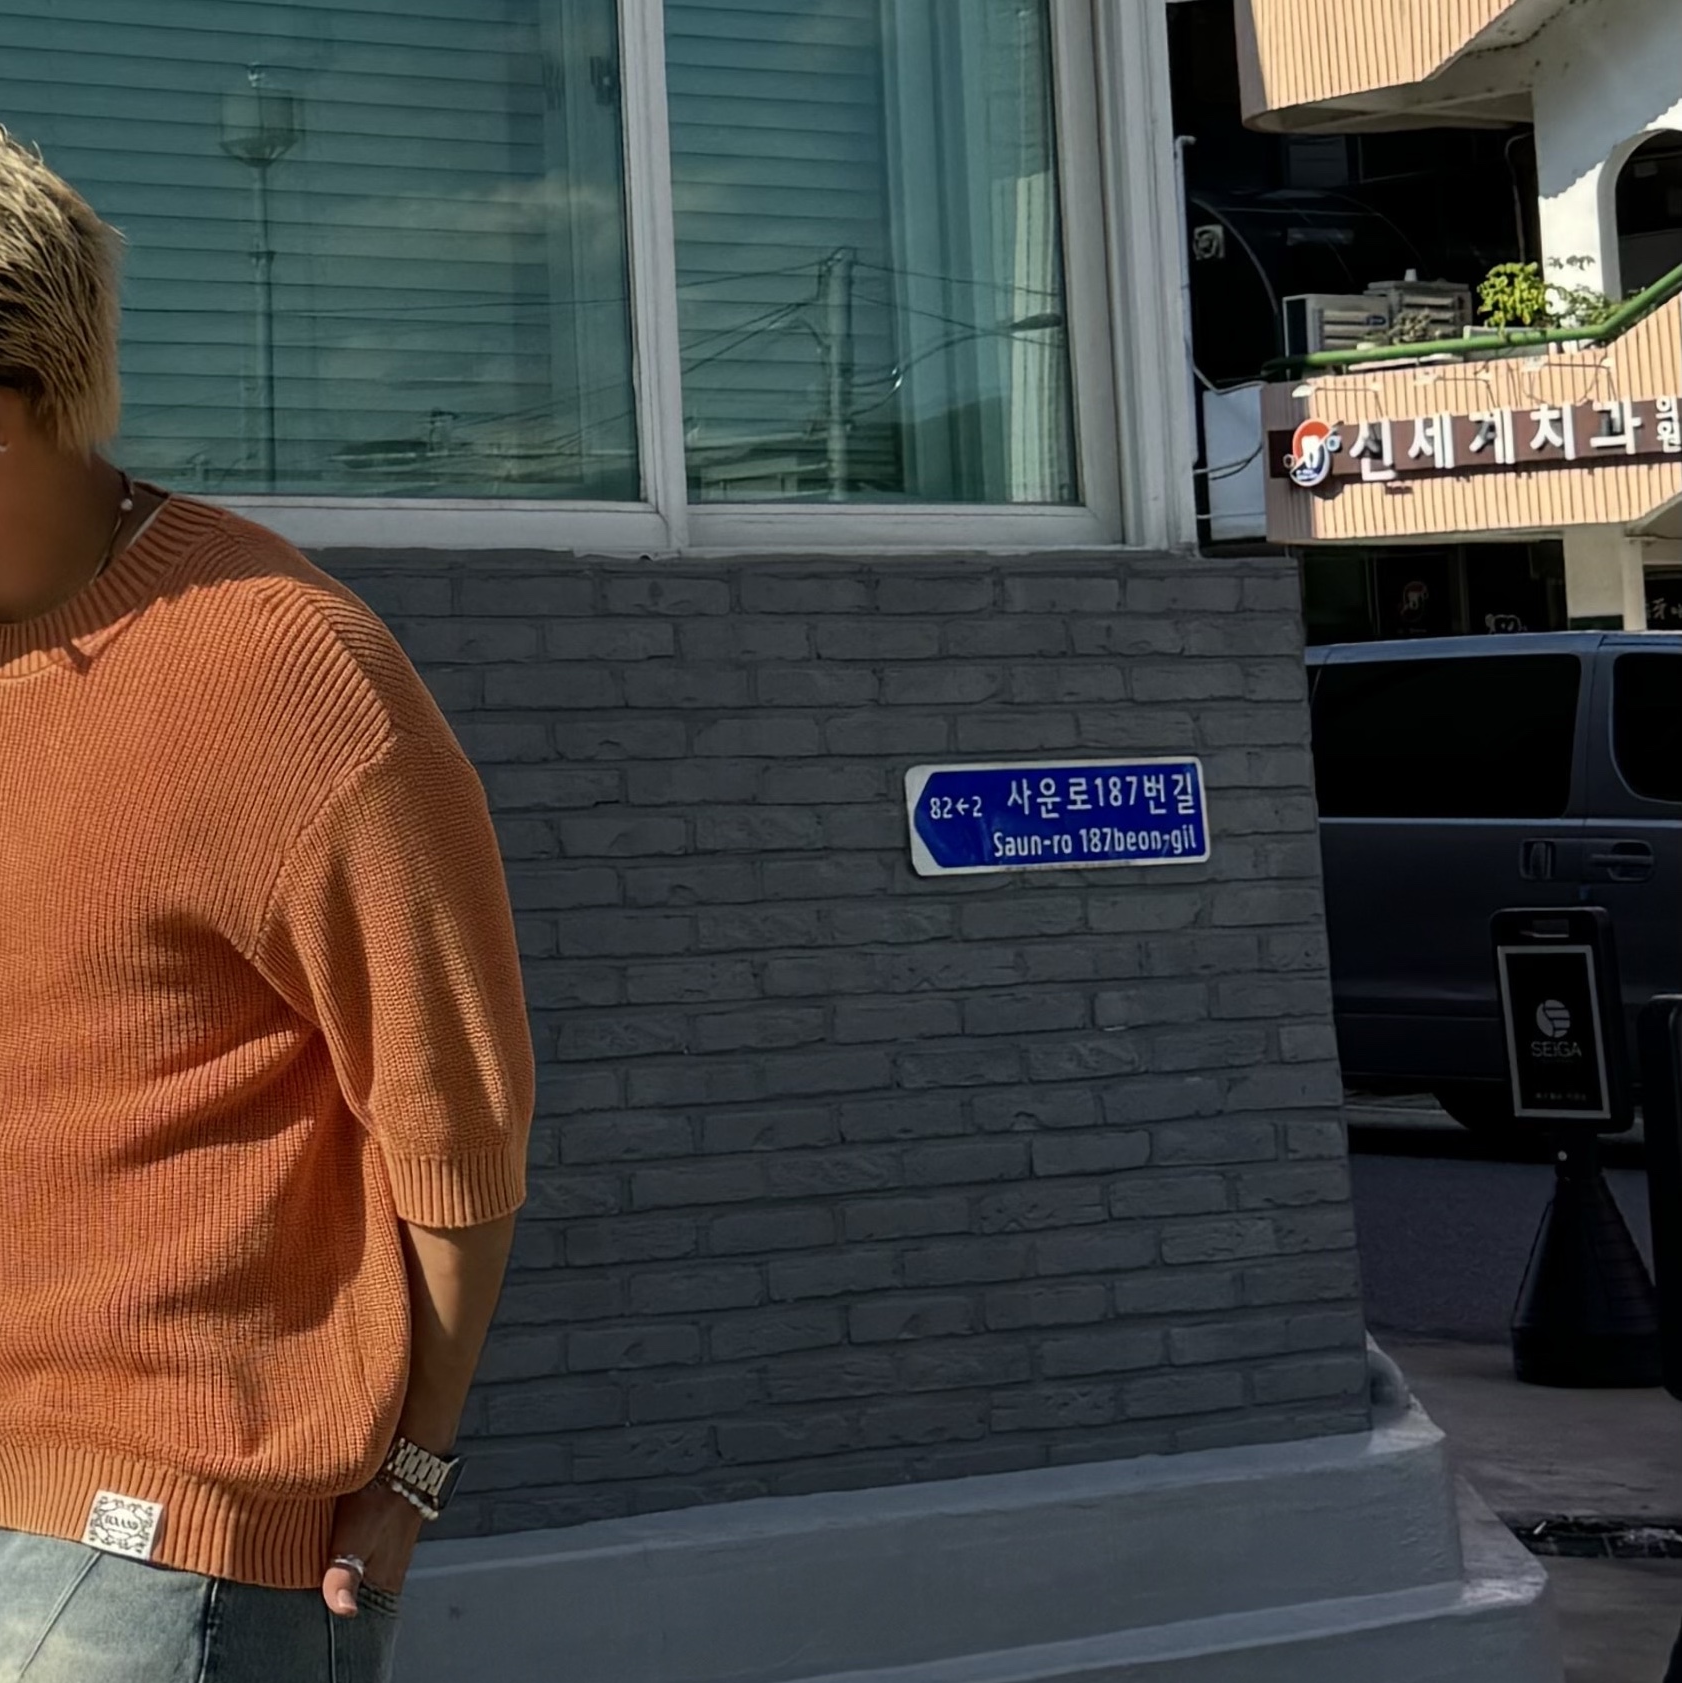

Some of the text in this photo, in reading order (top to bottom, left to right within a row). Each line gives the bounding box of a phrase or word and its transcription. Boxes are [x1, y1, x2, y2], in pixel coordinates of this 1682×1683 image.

[1349, 398, 1642, 481] 신세계치과
[1007, 772, 1195, 818] 사운로187번길
[994, 825, 1196, 857] Saun-ro 187beon-gil
